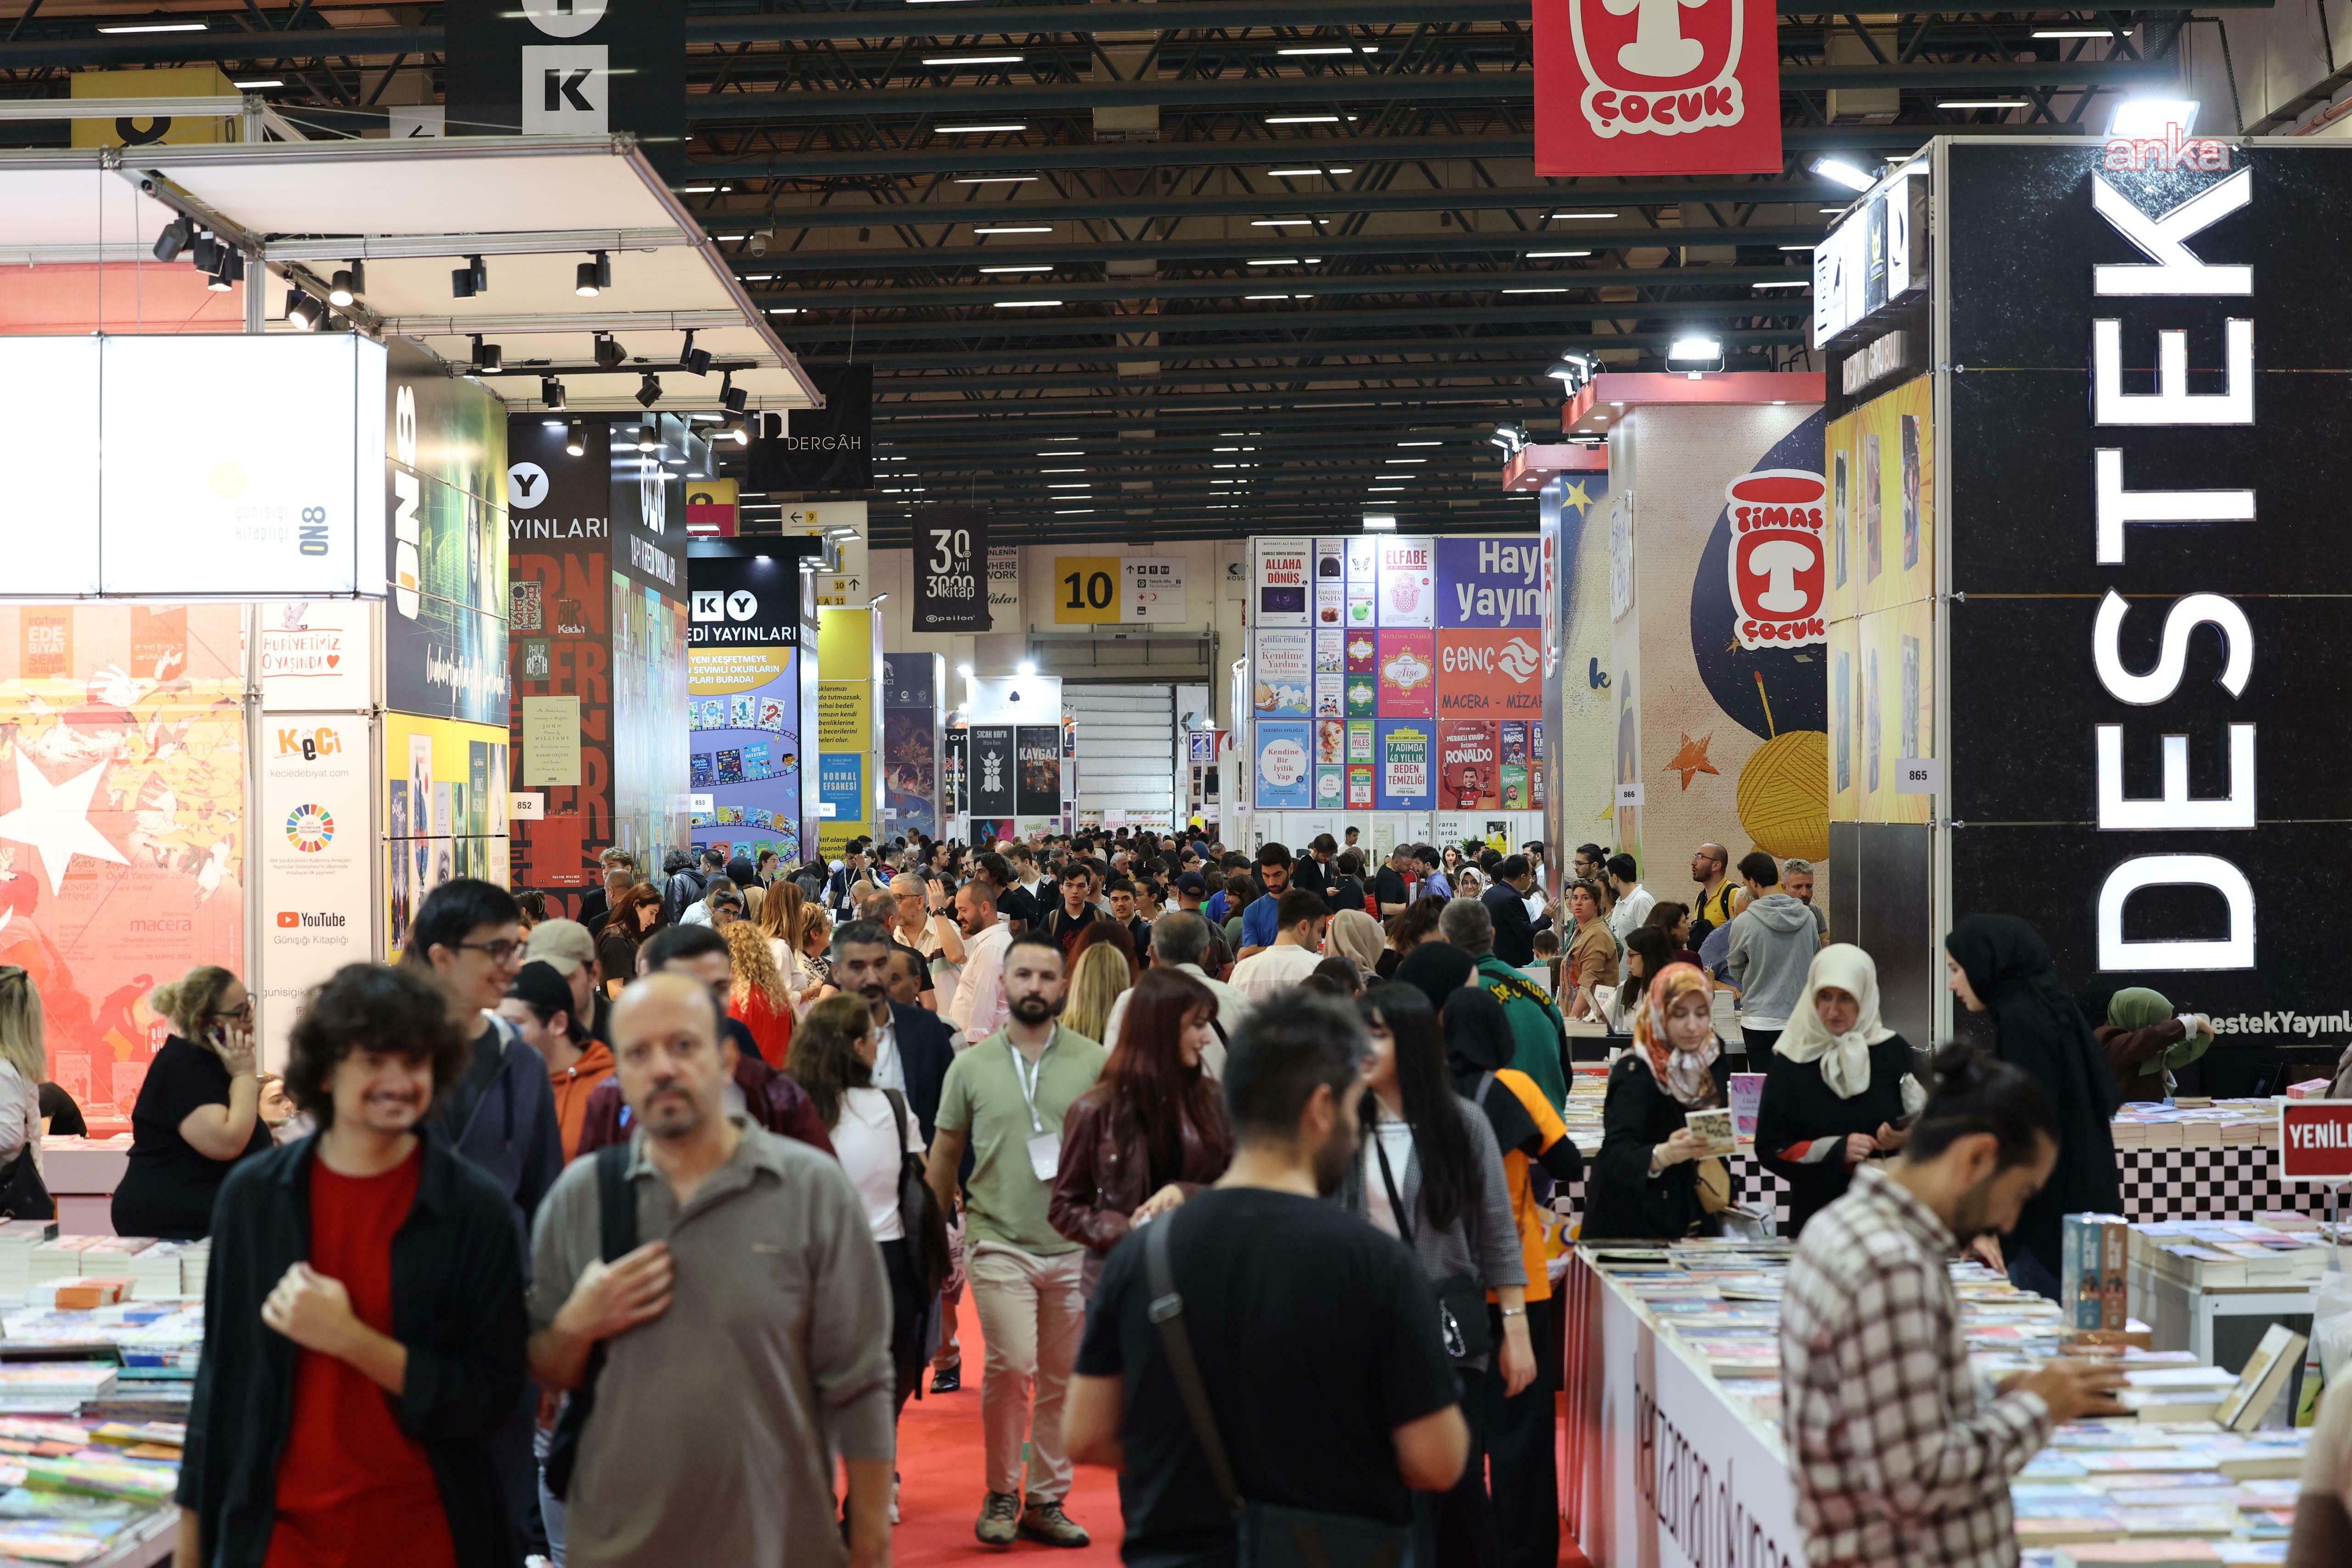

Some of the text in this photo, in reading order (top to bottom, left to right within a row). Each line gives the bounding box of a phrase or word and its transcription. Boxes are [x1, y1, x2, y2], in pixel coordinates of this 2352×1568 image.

[1592, 86, 1733, 127] ÇOCUK
[1843, 330, 1901, 395] MEDYA GRUBU
[788, 434, 861, 450] DERGÂH
[1735, 506, 1823, 535] TİMAŞ
[299, 506, 328, 556] ON8
[631, 534, 676, 587] YAPI KREDİ YAYINLARI
[1386, 550, 1427, 564] ELFABE
[954, 558, 969, 575] yıl
[2092, 165, 2256, 972] DESTEK
[1268, 571, 1300, 585] DÖNÜŞ
[942, 583, 975, 600] kitap
[1064, 572, 1113, 609] 10
[688, 625, 708, 642] EDİ
[712, 626, 796, 641] YAYINLARI
[1742, 618, 1825, 642] ÇOCUK
[528, 645, 545, 656] PHILIP
[1262, 651, 1304, 660] Kendime
[275, 656, 322, 672] YAŞINDA
[690, 653, 767, 666] YENİ KEŞFETMEYE
[694, 664, 780, 674] SEVİMLİ OKURLARIN
[1442, 694, 1489, 709] MACERA
[1504, 733, 1524, 744] Messi
[1019, 747, 1057, 761] KAVGAZ
[1390, 744, 1423, 752] 7 ADIMDA
[1401, 754, 1423, 762] YILLIK
[1446, 748, 1493, 764] RONALDO
[270, 769, 349, 779] keciedebiyat.com
[1274, 764, 1294, 773] İyilik
[1394, 765, 1419, 773] BEDEN
[1909, 769, 1928, 781] 865
[823, 772, 856, 780] NORMAL
[1388, 774, 1425, 784] TEMİZLİĞİ
[1503, 775, 1525, 784] Neymar
[823, 782, 856, 790] EFSANESİ
[106, 861, 137, 869] Zeynep
[106, 872, 168, 880] Öykü Yarışması
[130, 919, 192, 931] macera
[301, 912, 345, 926] YouTube
[274, 935, 348, 946] Günışığı Kitaplığı
[2178, 1010, 2352, 1038] estekYayınl
